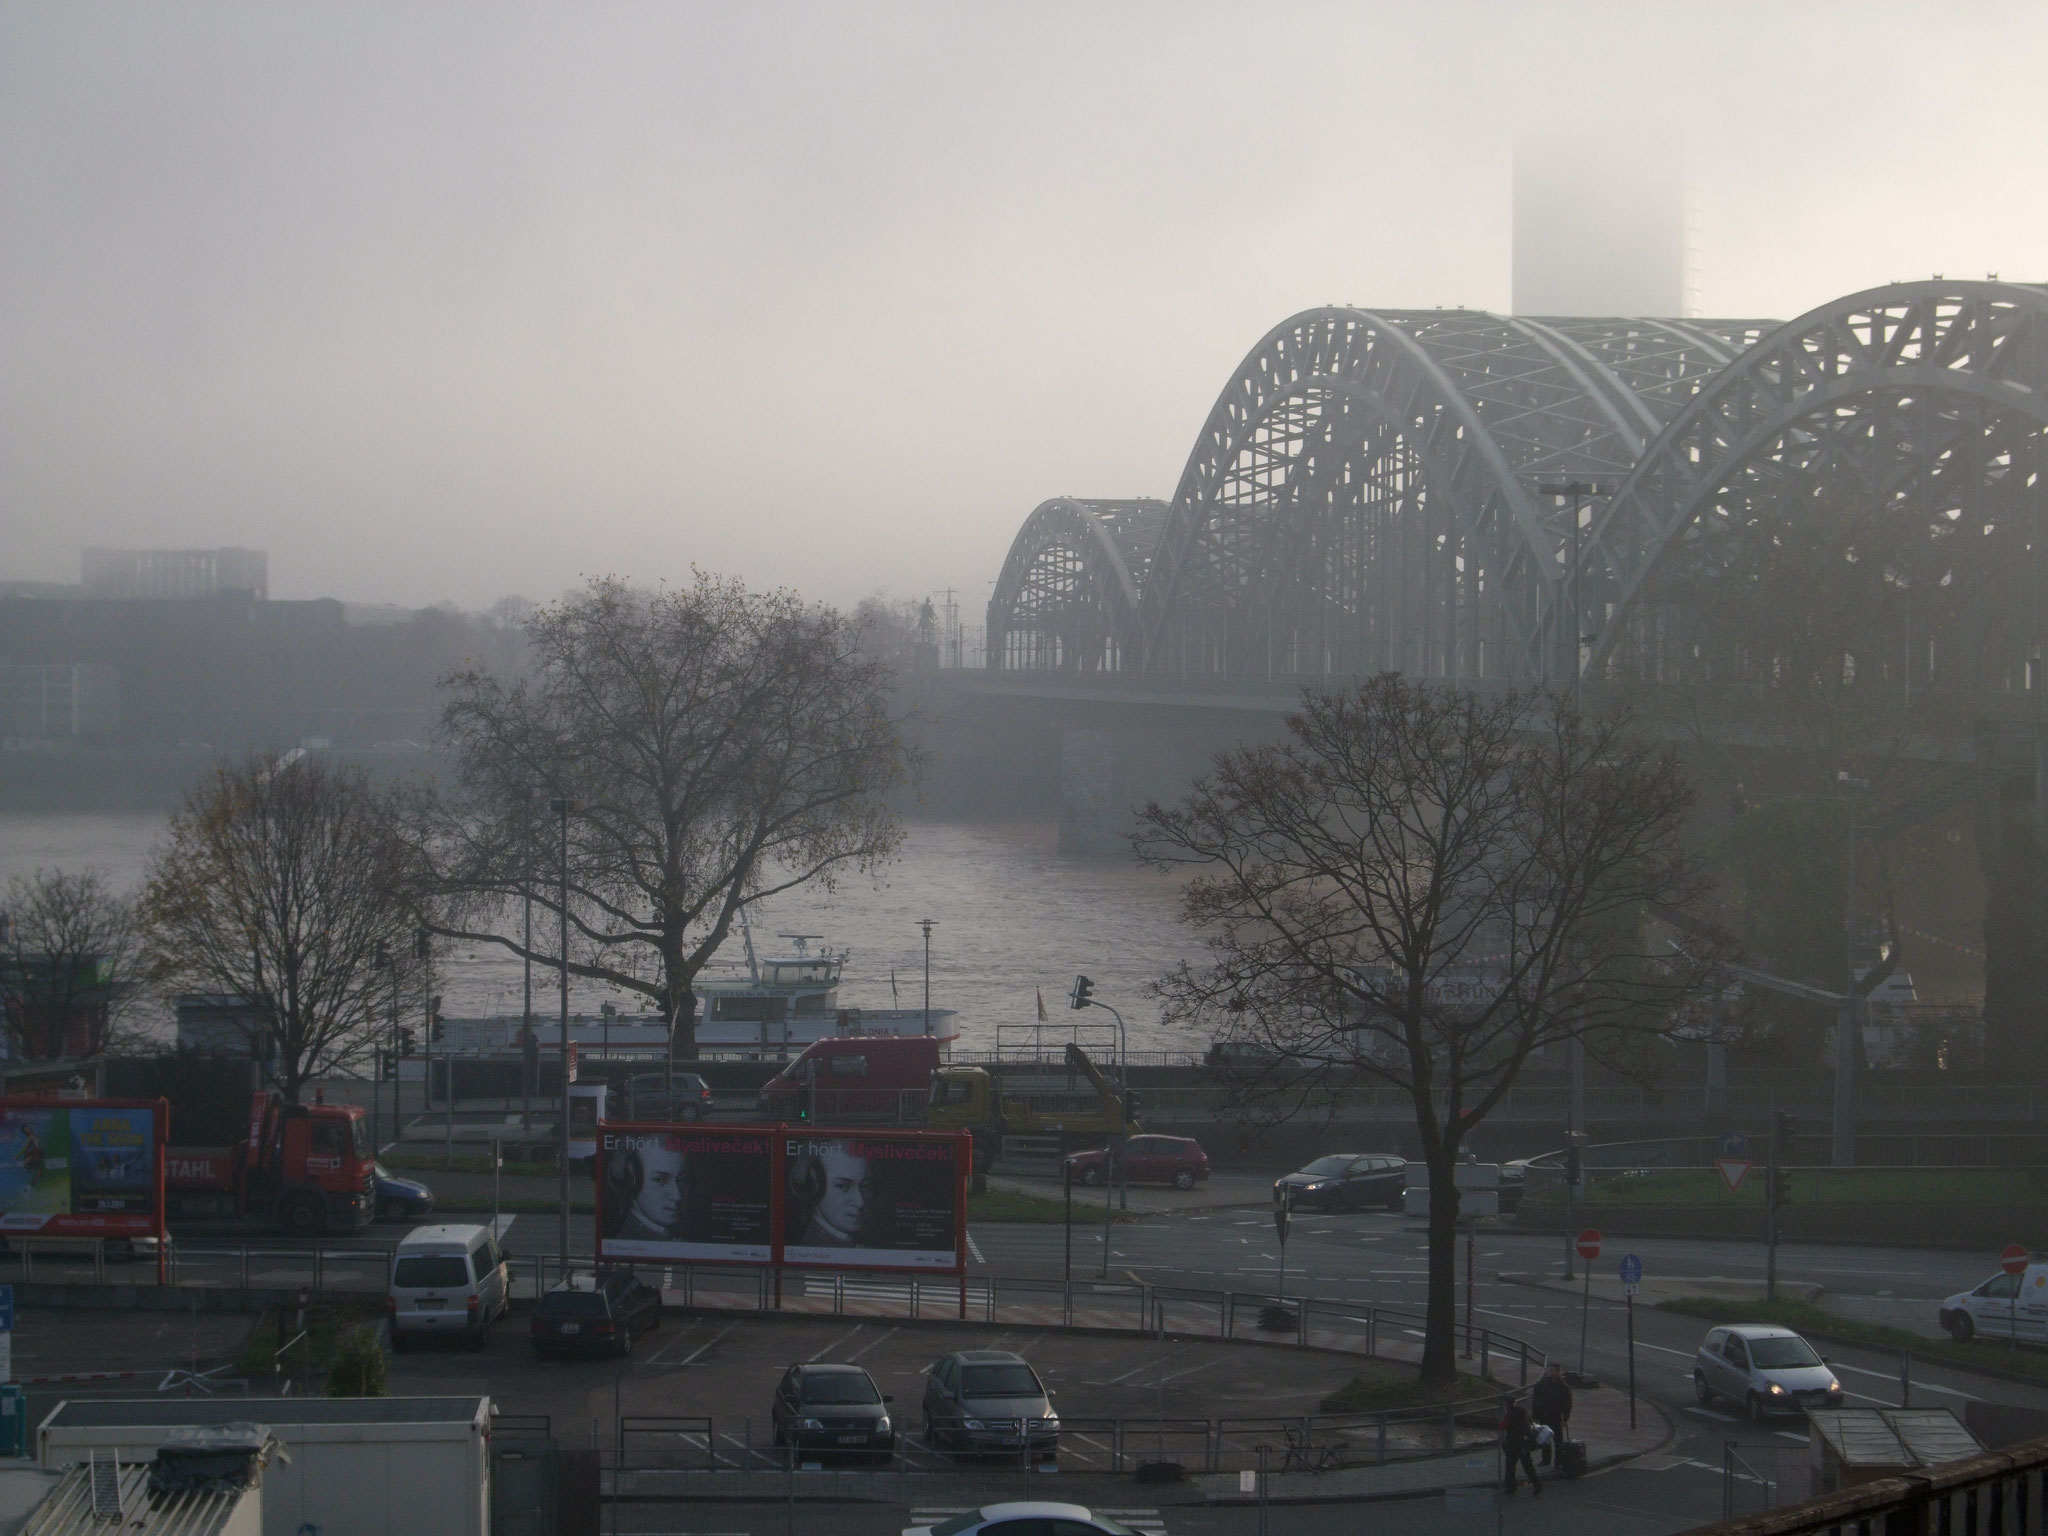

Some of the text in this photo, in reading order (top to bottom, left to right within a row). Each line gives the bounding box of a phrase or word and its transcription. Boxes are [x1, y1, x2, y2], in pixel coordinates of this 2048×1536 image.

[603, 1134, 769, 1154] Er hört Mysliveček!
[786, 1140, 954, 1161] Er hört Mysliveček!
